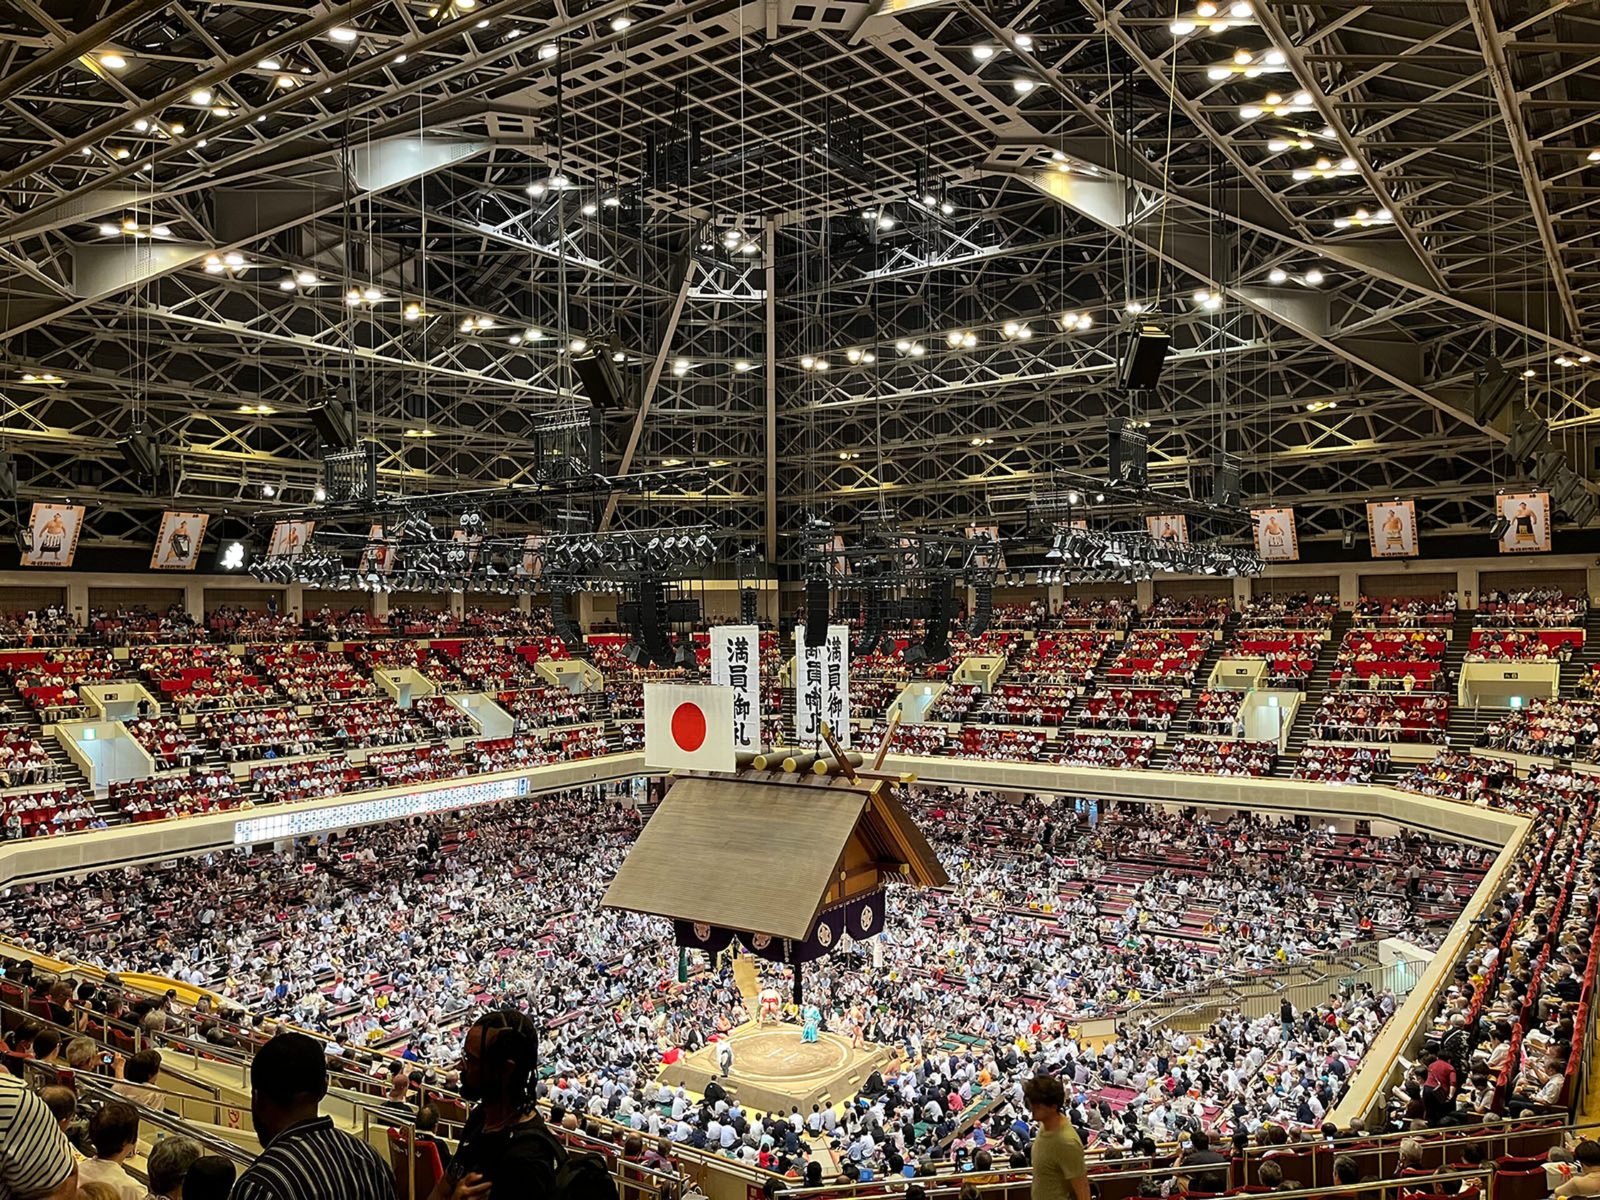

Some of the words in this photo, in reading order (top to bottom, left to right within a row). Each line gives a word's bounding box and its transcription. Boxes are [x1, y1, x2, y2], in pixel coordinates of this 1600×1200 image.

[727, 636, 751, 746] 満員御礼
[826, 636, 843, 742] 満員御礼
